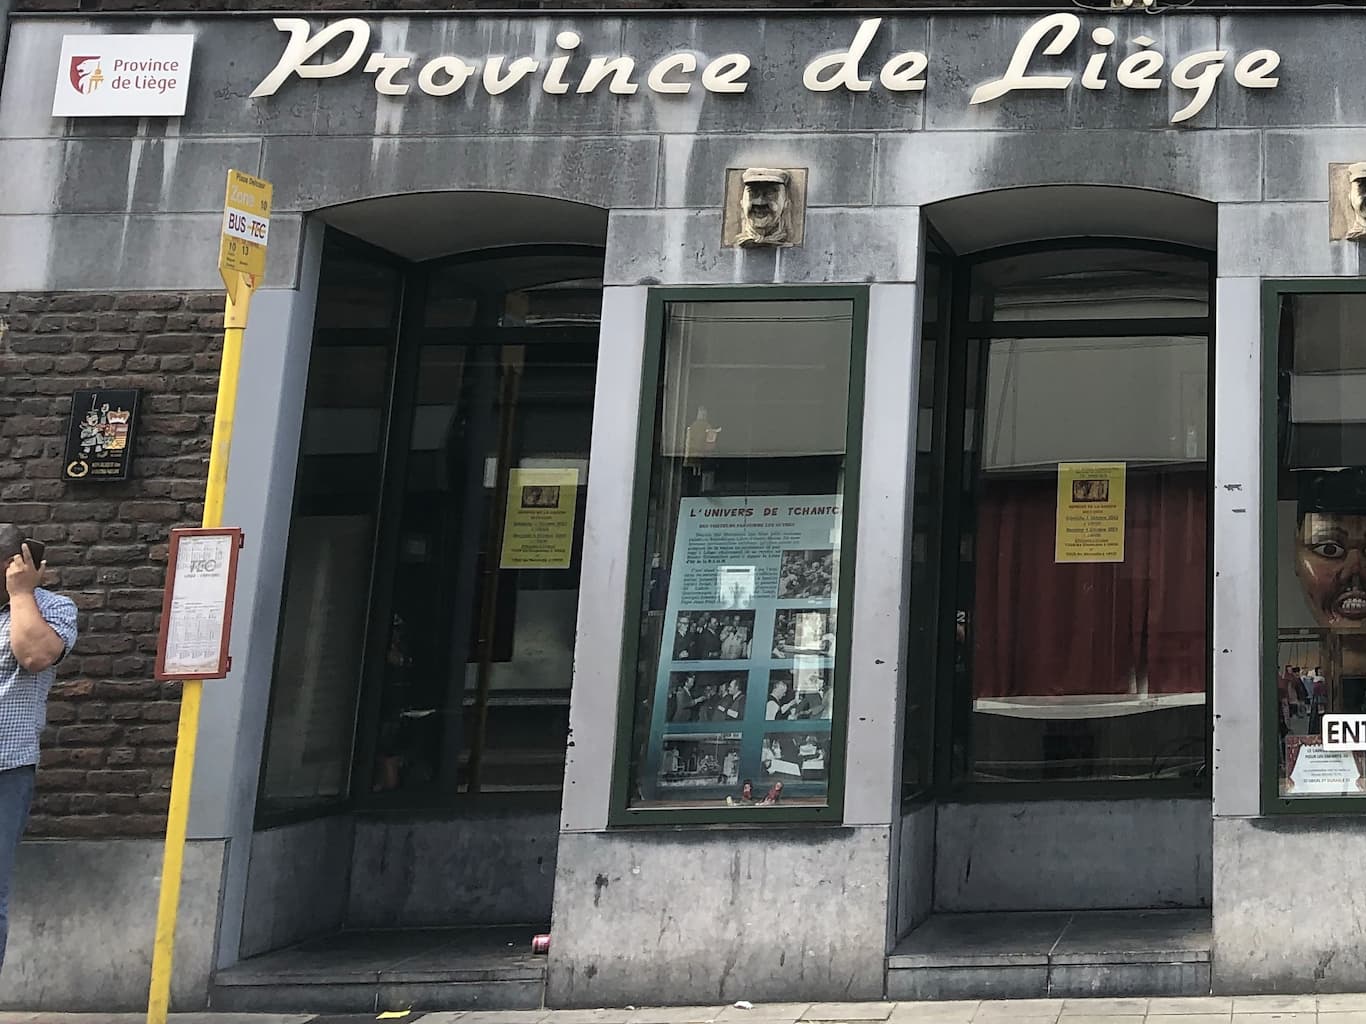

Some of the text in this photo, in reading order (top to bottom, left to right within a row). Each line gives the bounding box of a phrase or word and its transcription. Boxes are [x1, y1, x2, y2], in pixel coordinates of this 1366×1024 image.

[113, 58, 179, 72] Province
[249, 17, 751, 98] Province
[802, 17, 929, 92] de
[969, 12, 1281, 124] Liège
[111, 75, 177, 94] de Liège
[230, 185, 255, 208] Zone
[228, 213, 267, 239] BUS TEC
[763, 507, 779, 517] DE
[190, 559, 217, 573] TEC
